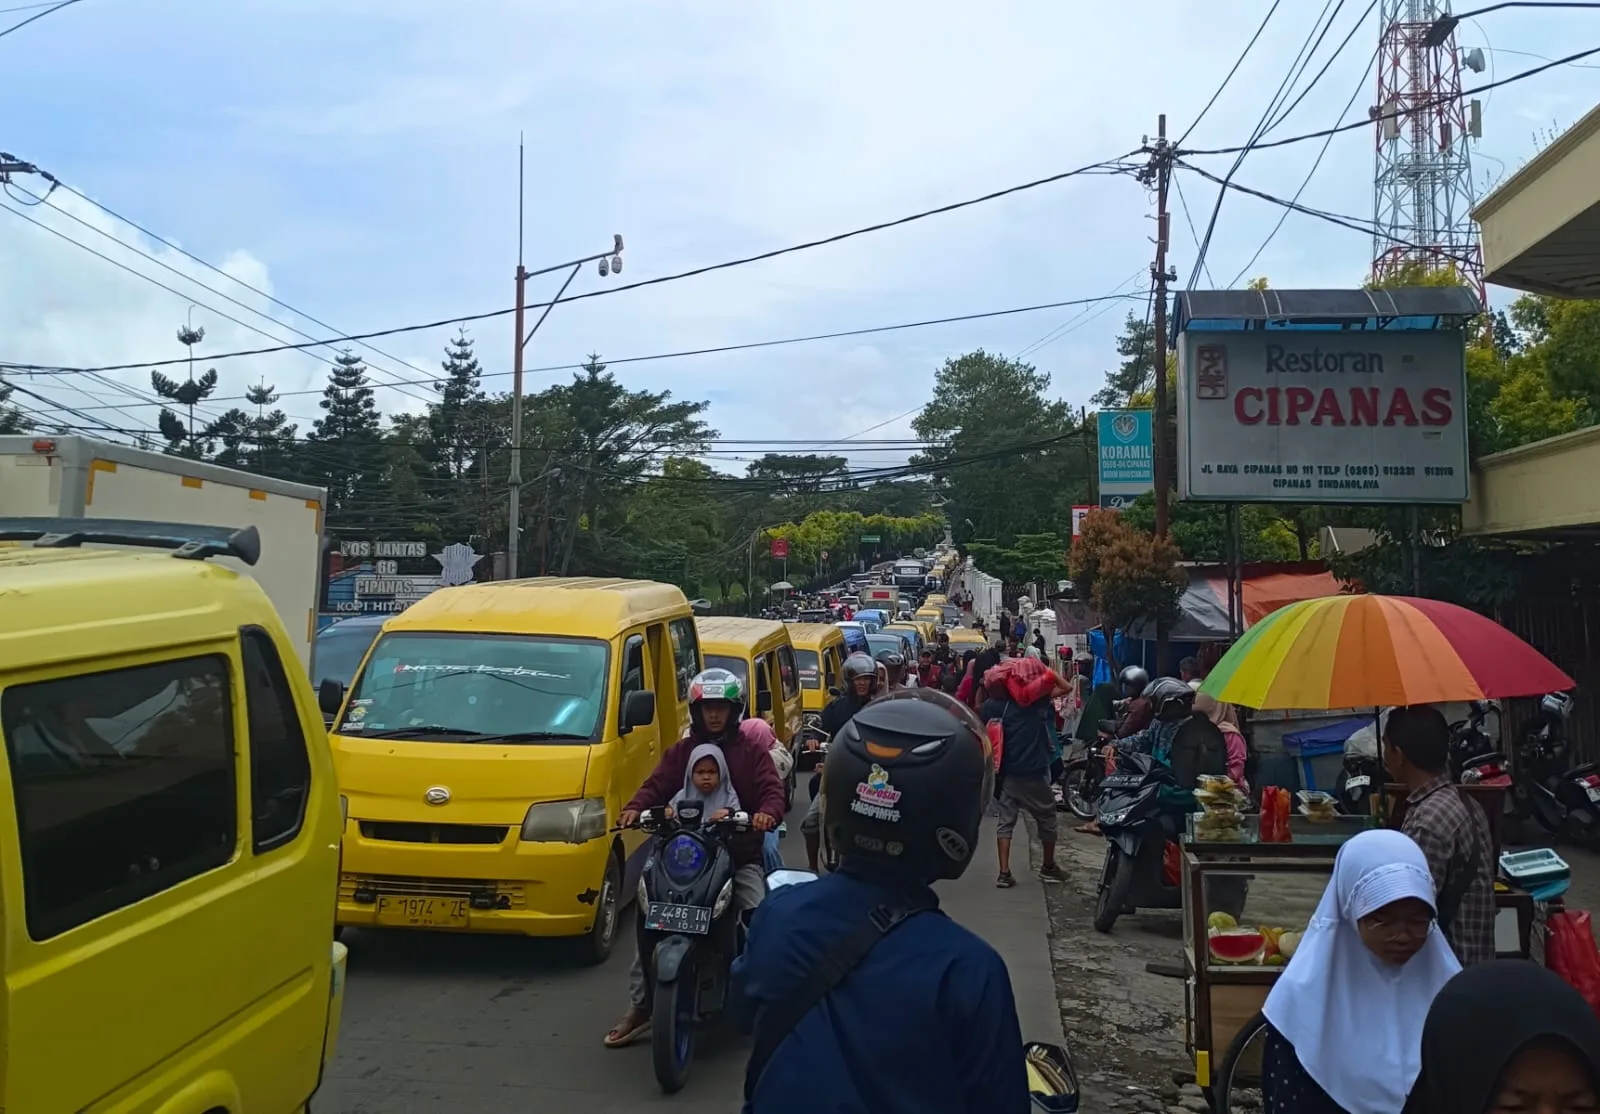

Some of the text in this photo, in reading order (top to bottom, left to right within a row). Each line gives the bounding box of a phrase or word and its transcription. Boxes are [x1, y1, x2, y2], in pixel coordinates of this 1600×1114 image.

[1265, 345, 1384, 373] Restoran
[1233, 387, 1454, 427] CIPANAS
[1101, 445, 1151, 459] KORAMIL
[1201, 464, 1213, 474] JL
[1216, 464, 1239, 474] RAYA
[1243, 464, 1283, 474] CIPANAS
[1317, 465, 1341, 475] TELP
[1272, 479, 1312, 488] CIPANAS
[375, 541, 426, 557] LANTAS
[355, 580, 413, 594] CIPANAS
[336, 601, 368, 611] KOPI
[378, 898, 388, 914] F
[398, 899, 433, 917] 1974
[650, 905, 658, 916] F
